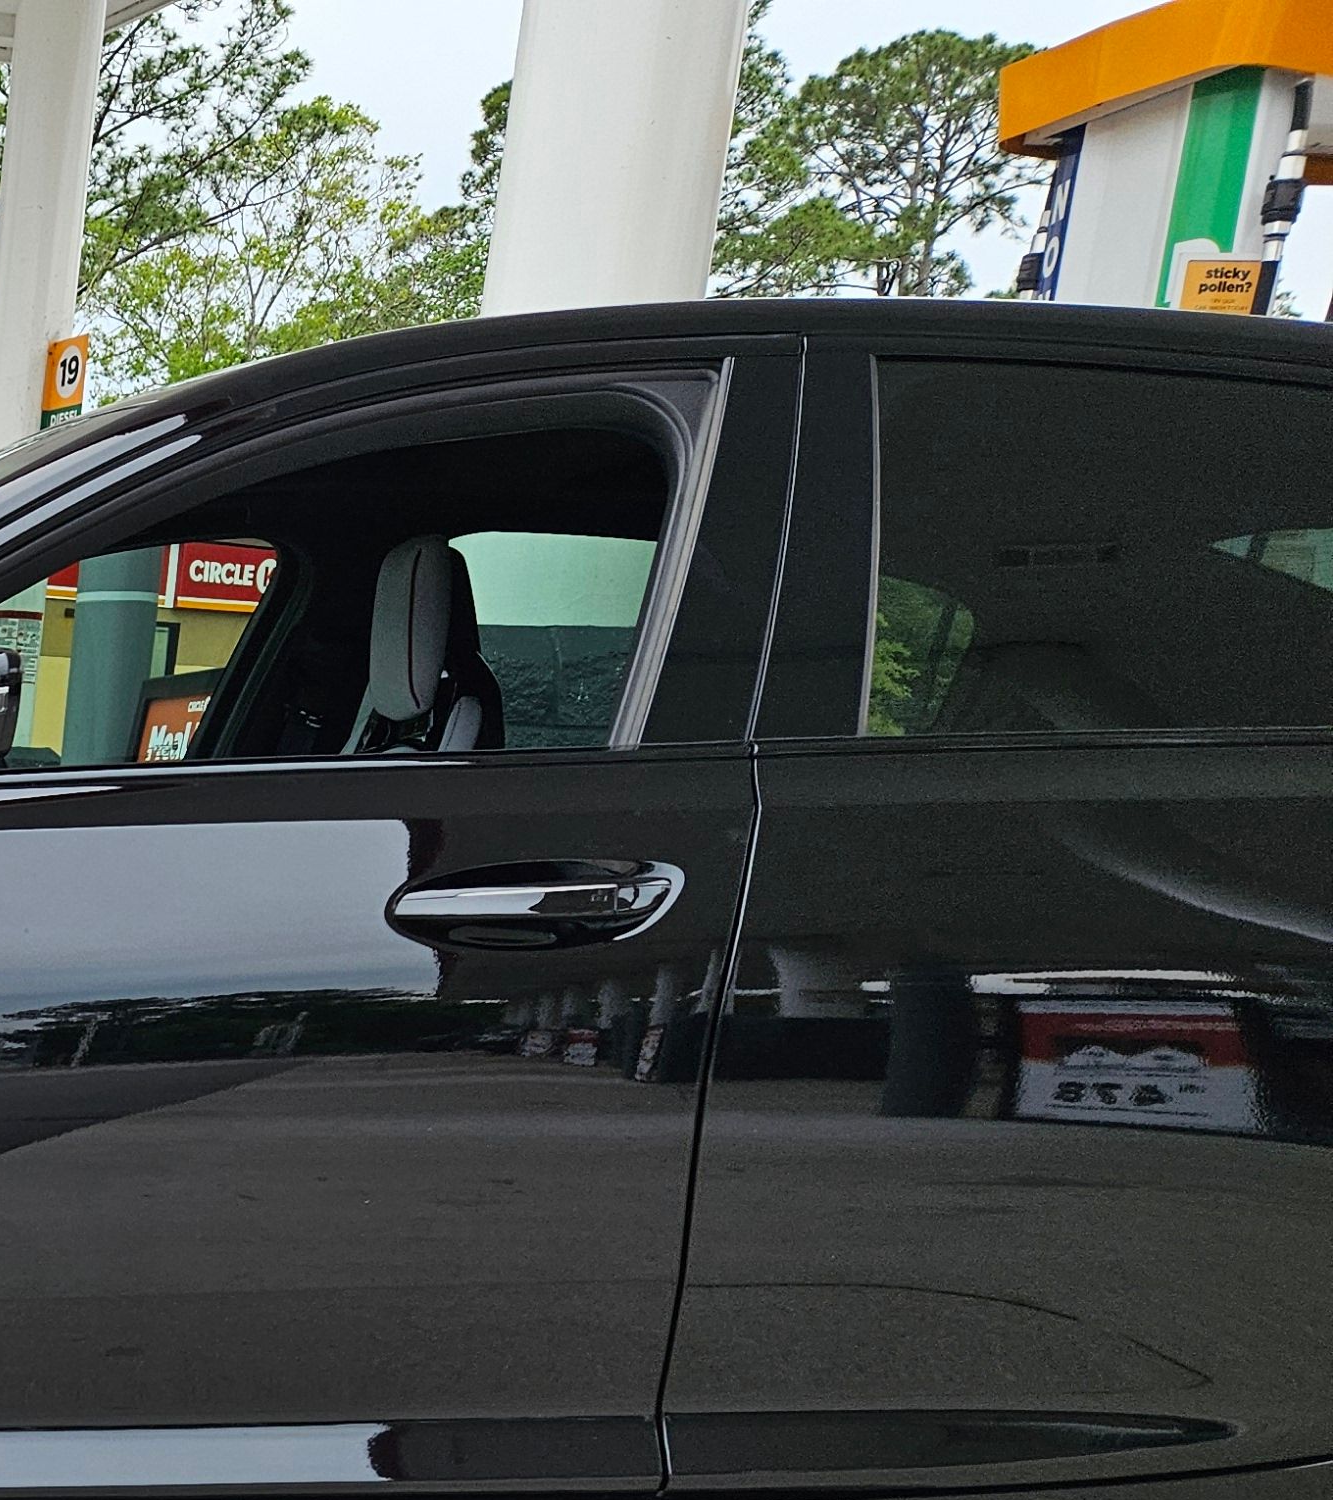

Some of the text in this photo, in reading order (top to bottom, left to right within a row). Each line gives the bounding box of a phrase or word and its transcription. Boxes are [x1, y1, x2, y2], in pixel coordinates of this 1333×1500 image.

[1205, 267, 1251, 281] sticky
[1198, 281, 1252, 295] pollen?
[60, 355, 79, 387] 19
[189, 559, 255, 586] CIRCLE
